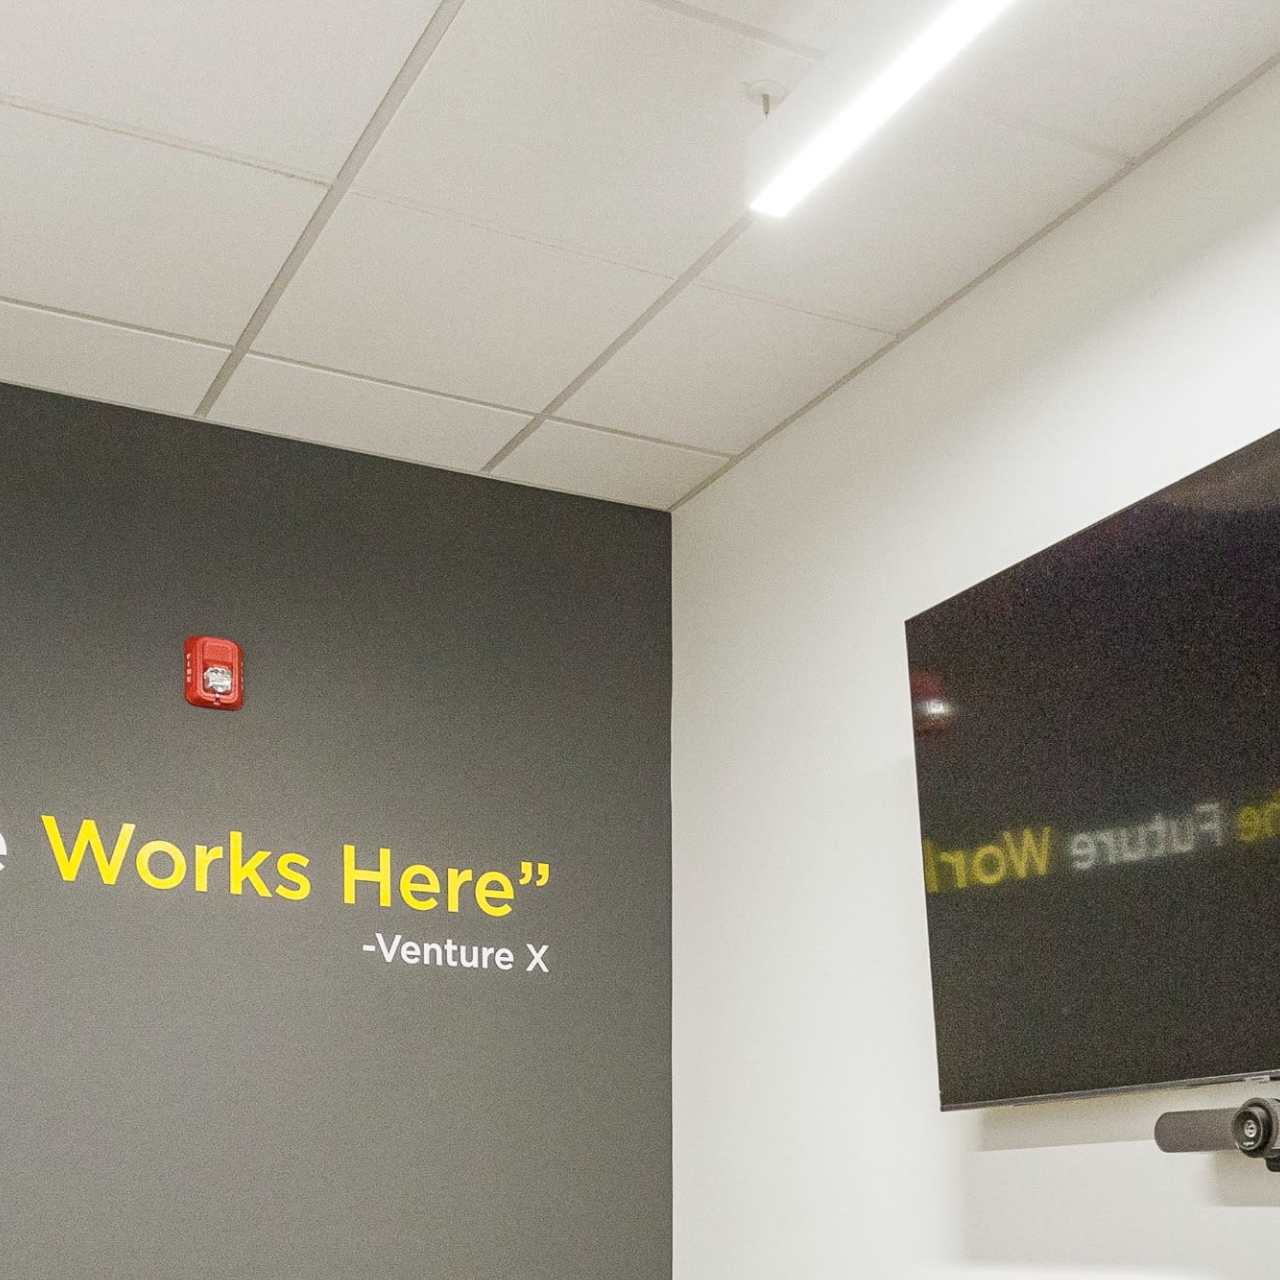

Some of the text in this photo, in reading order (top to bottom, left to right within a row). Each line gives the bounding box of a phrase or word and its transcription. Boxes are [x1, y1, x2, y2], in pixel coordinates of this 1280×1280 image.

[40, 815, 314, 904] Works
[342, 843, 552, 920] Here”
[526, 943, 549, 973] X
